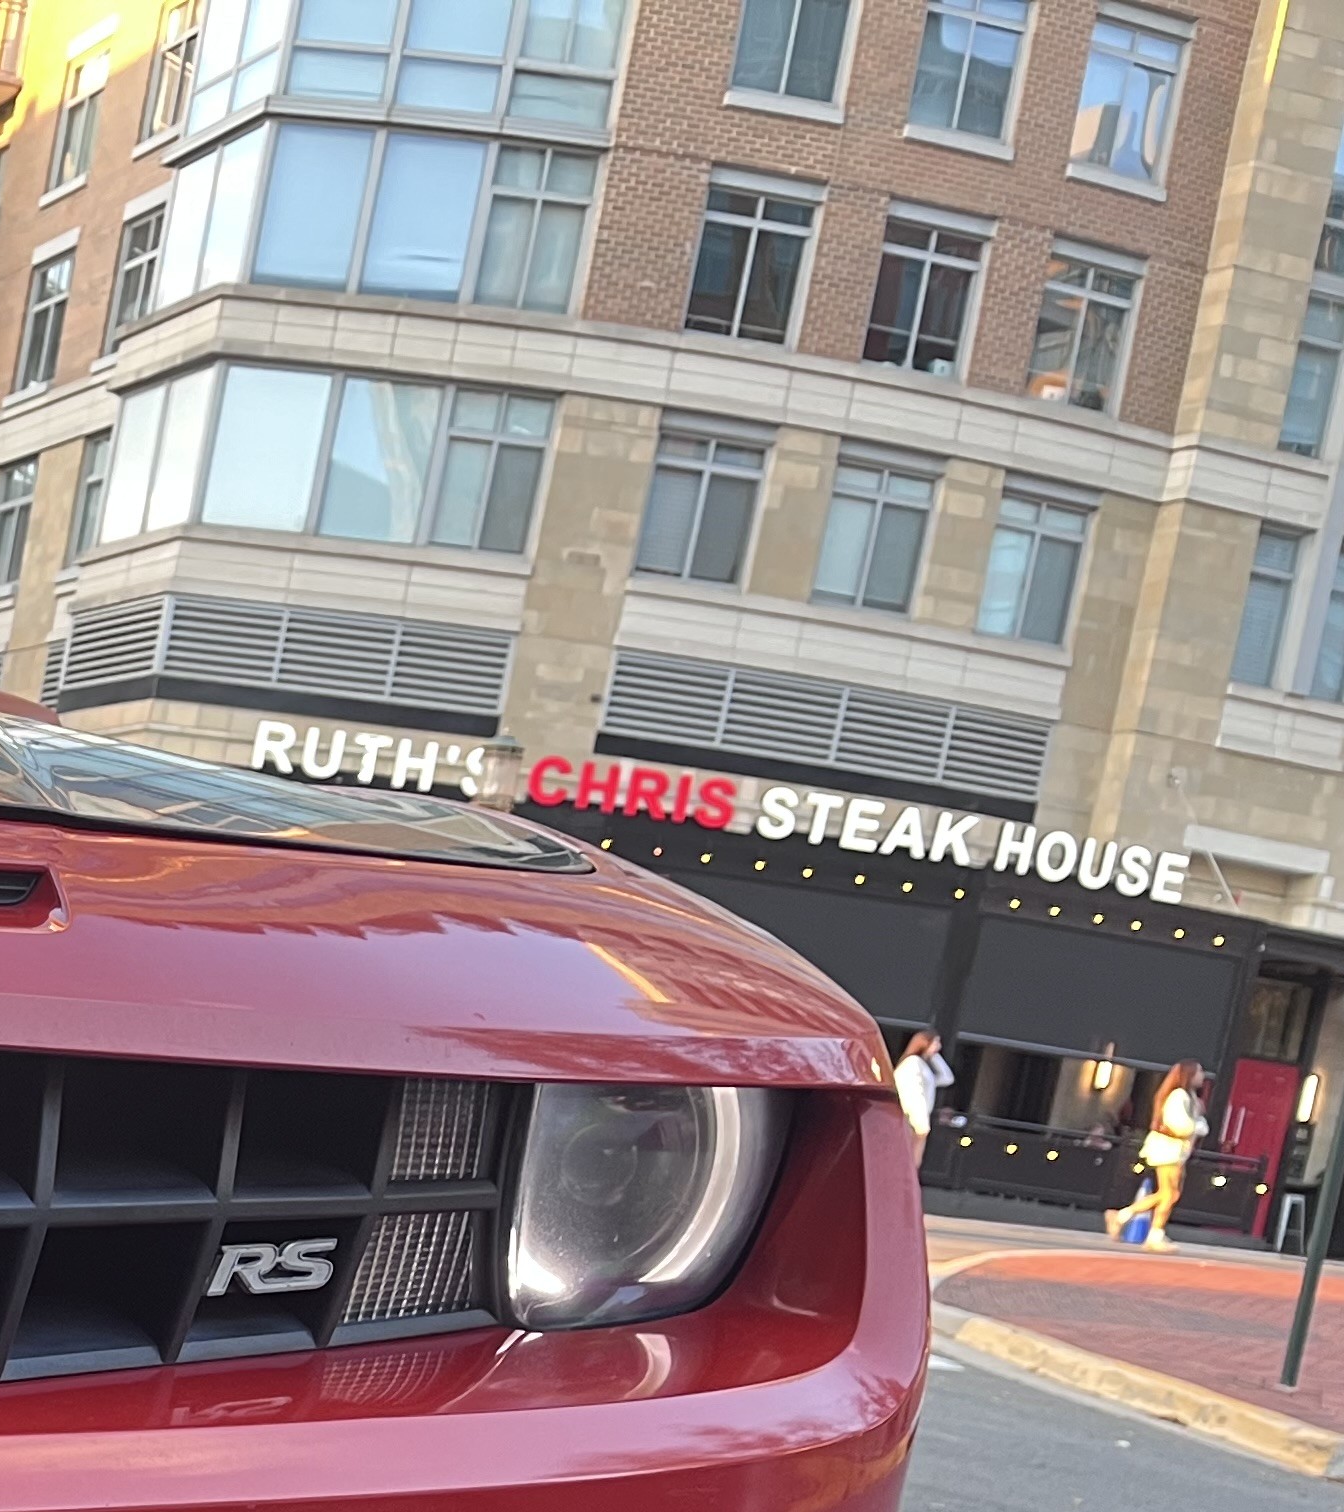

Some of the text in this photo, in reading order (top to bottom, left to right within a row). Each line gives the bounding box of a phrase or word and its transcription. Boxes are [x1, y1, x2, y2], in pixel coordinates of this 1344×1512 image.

[527, 755, 738, 830] CHRIS
[755, 786, 981, 867] STEAK
[992, 820, 1191, 905] HOUSE
[207, 1238, 338, 1297] RS
